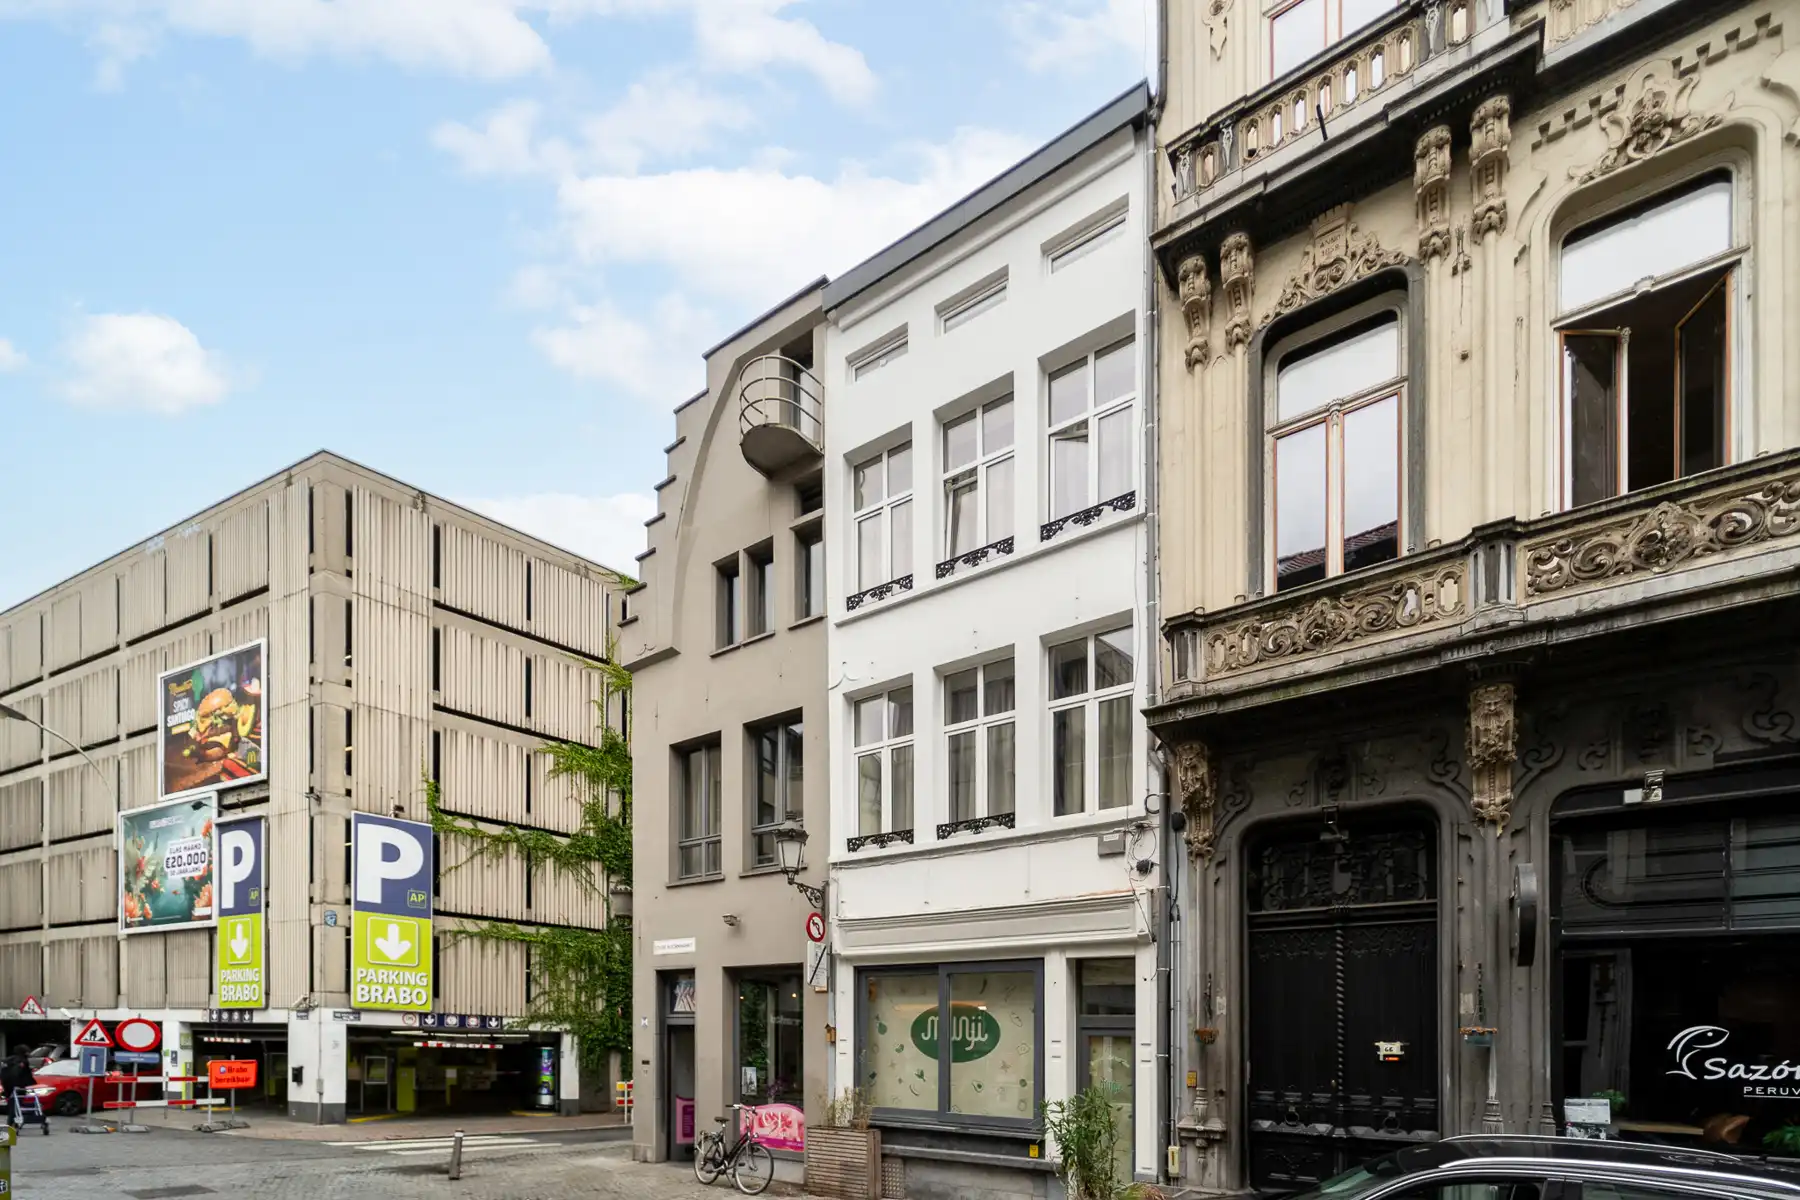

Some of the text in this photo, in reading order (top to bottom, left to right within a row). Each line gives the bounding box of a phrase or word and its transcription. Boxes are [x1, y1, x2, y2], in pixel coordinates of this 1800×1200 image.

[165, 851, 207, 869] €20.000
[221, 829, 255, 909] P
[356, 822, 424, 904] P
[410, 892, 425, 902] AP
[221, 967, 259, 984] PARKING
[356, 968, 428, 986] PARKING
[221, 984, 259, 1002] BRABO
[356, 984, 428, 1006] BRABO
